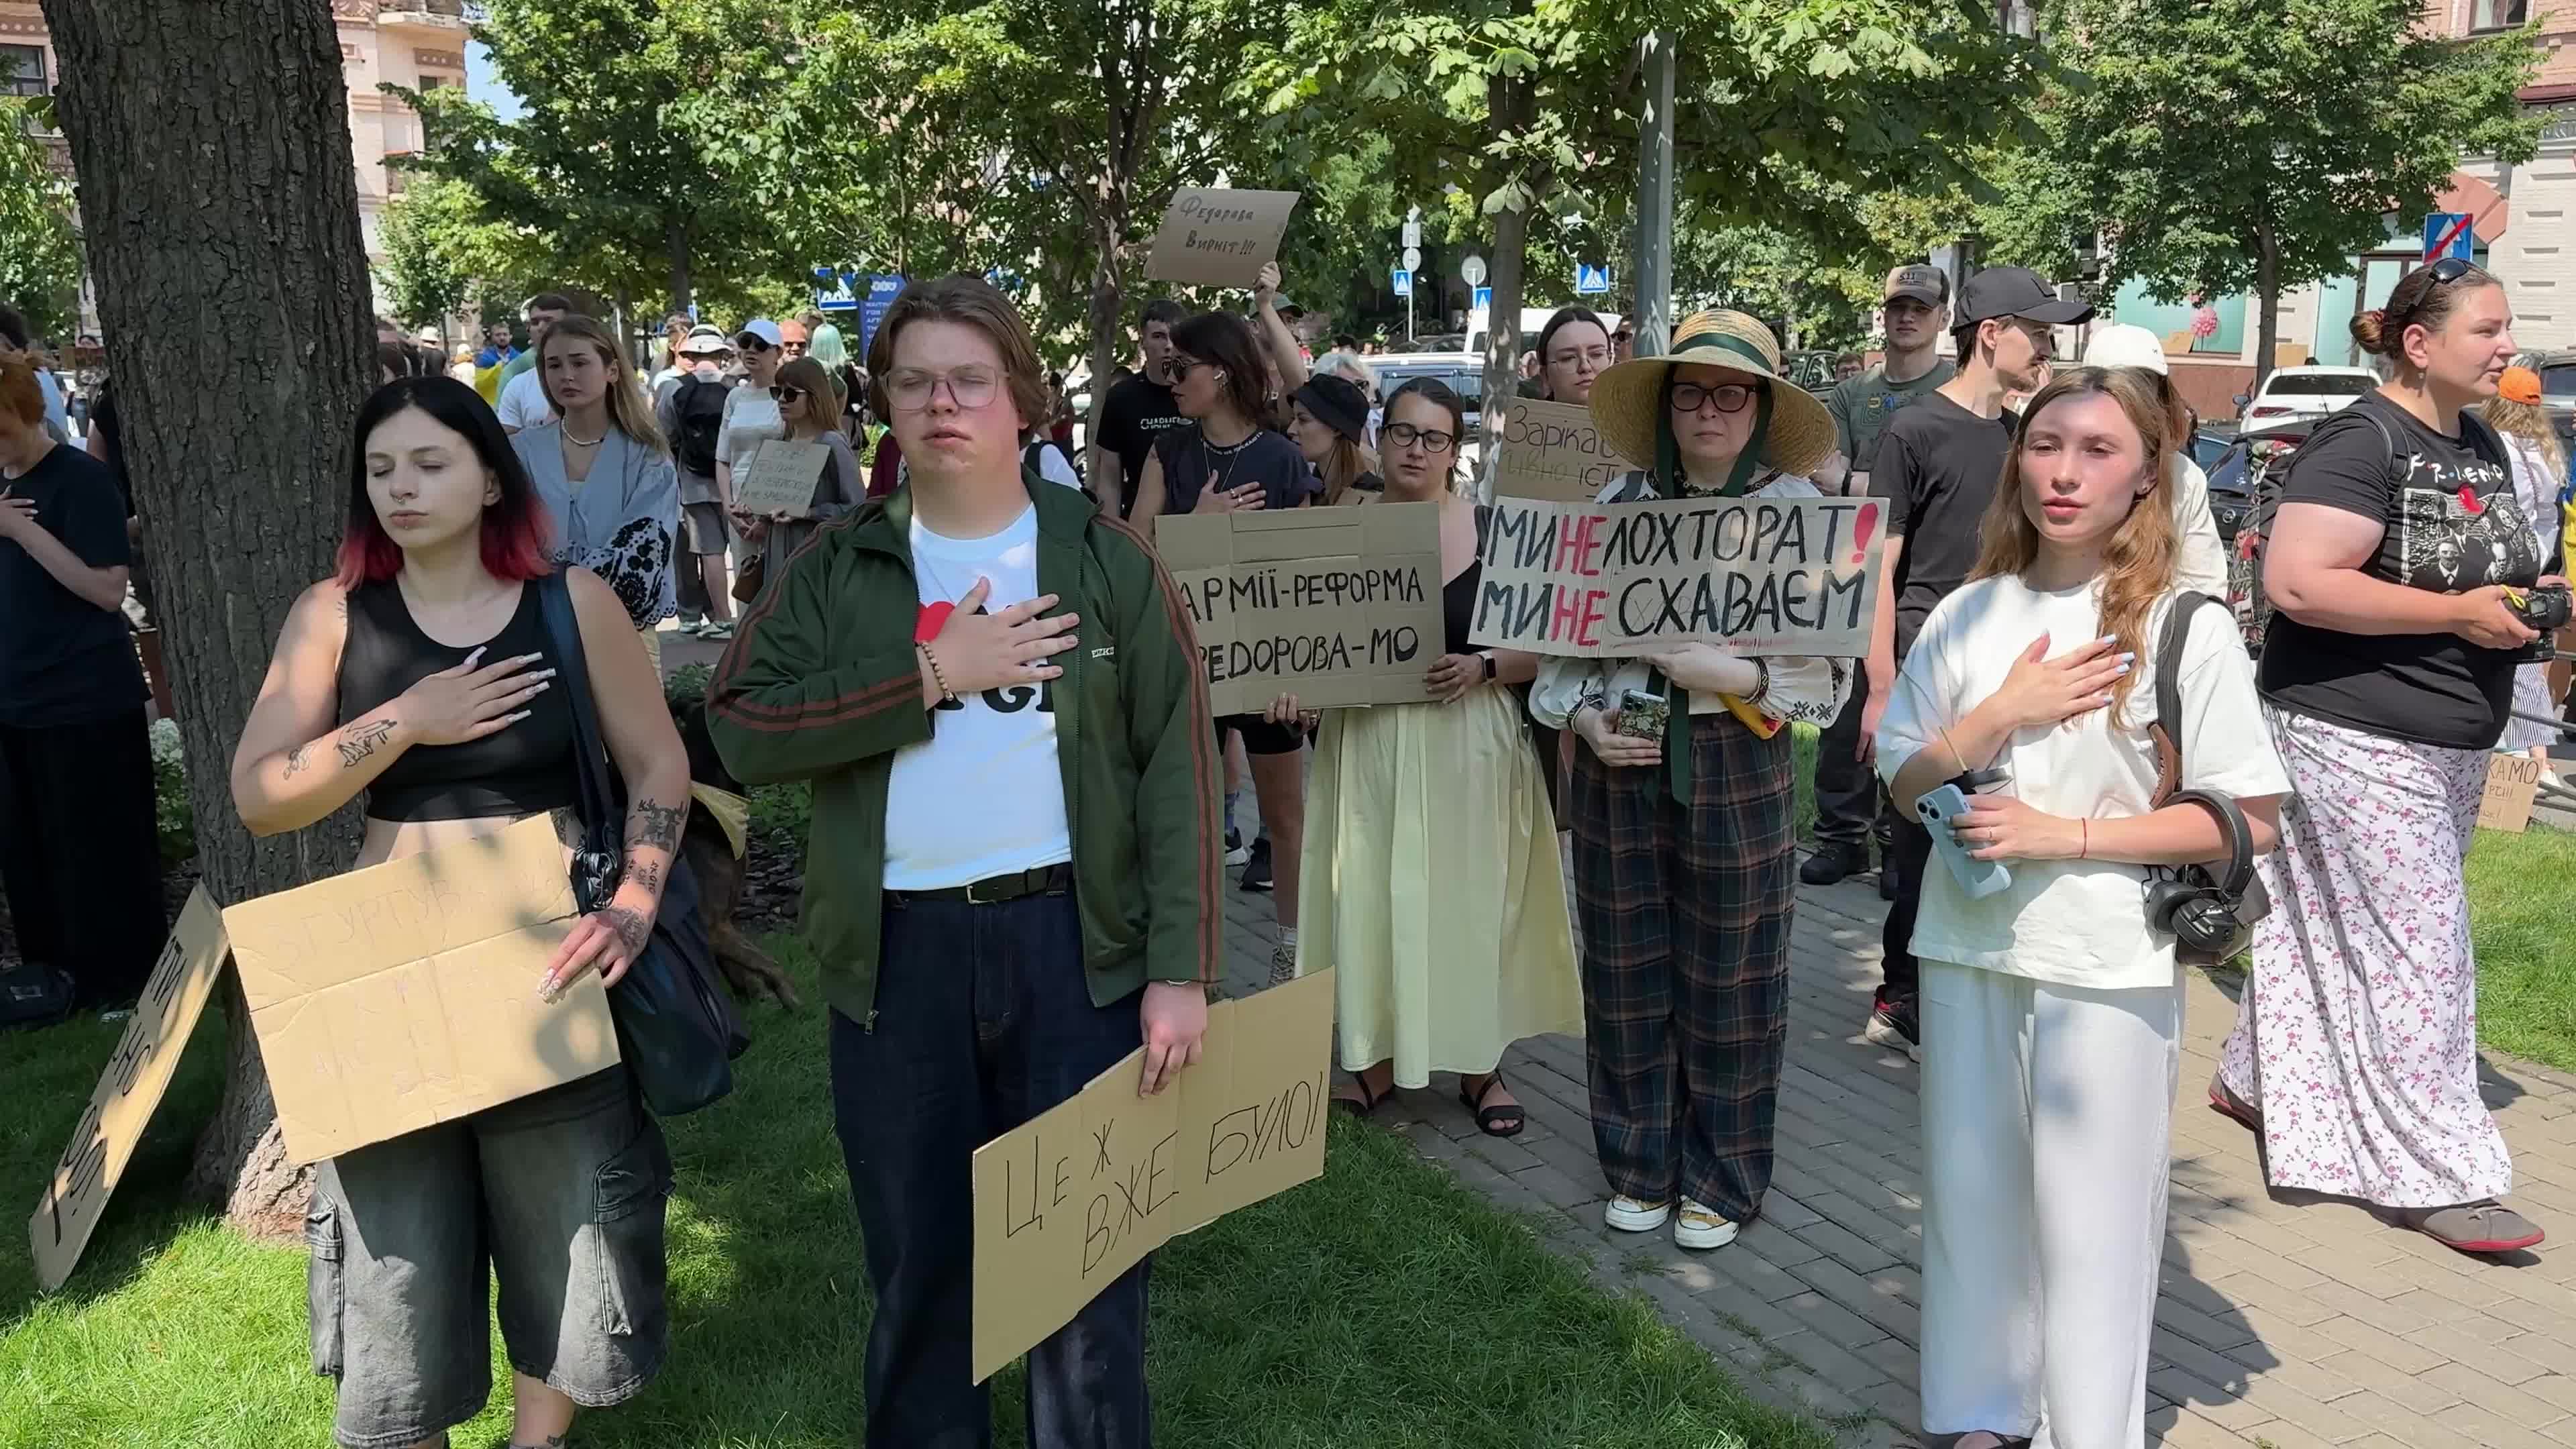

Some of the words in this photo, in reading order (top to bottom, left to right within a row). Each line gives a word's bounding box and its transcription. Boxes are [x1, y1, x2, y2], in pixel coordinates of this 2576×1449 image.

[1488, 504, 1557, 573] МИ
[1555, 514, 1608, 576] НЕ
[1477, 580, 1554, 641] МИ
[1550, 584, 1609, 647] НЕ
[1619, 570, 1866, 637] СХАВАЄМ
[1082, 1130, 1180, 1280] ВЖЕ
